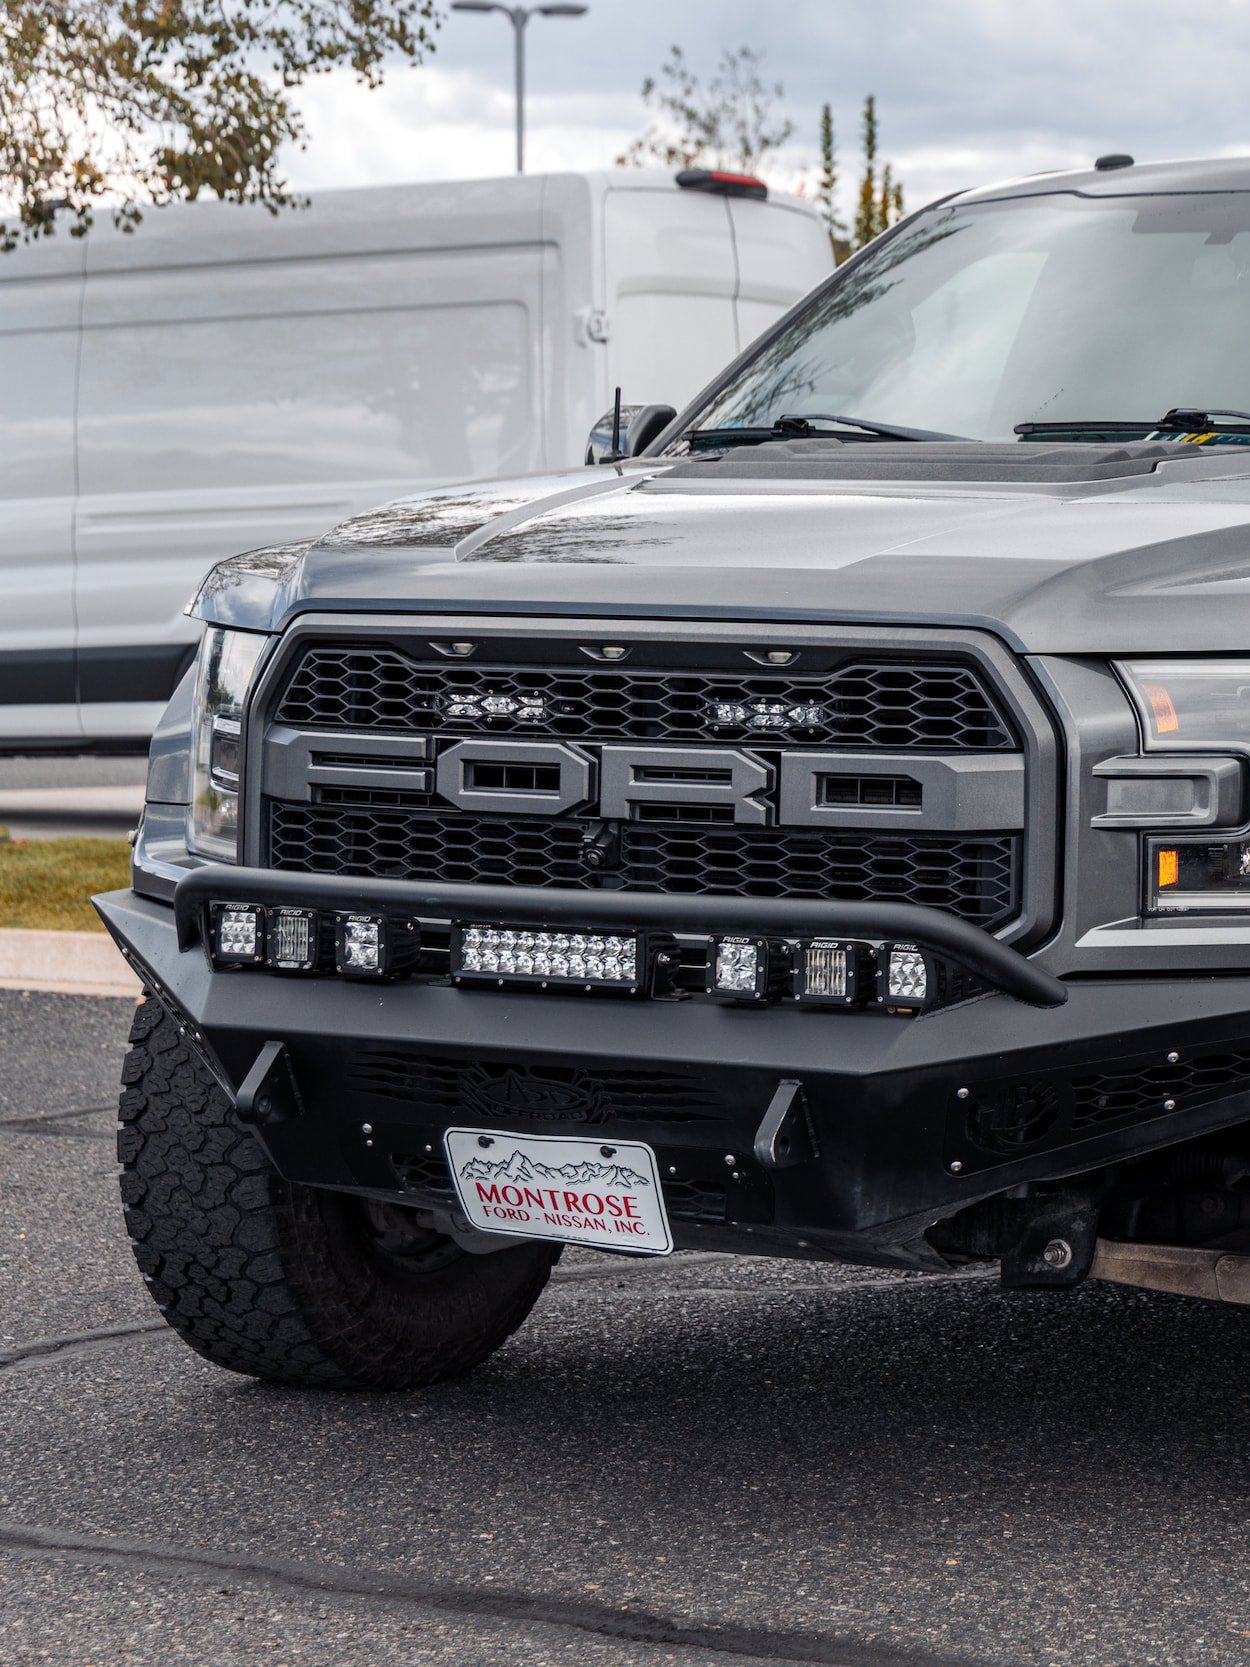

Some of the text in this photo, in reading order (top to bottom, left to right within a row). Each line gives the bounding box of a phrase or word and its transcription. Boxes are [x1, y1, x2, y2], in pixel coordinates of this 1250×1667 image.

[262, 729, 1024, 832] FORD
[225, 903, 249, 911] RIGID
[722, 936, 750, 944] RIGID
[809, 941, 839, 949] RIGID
[475, 1182, 642, 1219] MONTROSE
[482, 1205, 530, 1222] FORD
[544, 1212, 612, 1234] NISSAN,
[615, 1221, 651, 1236] INC.
